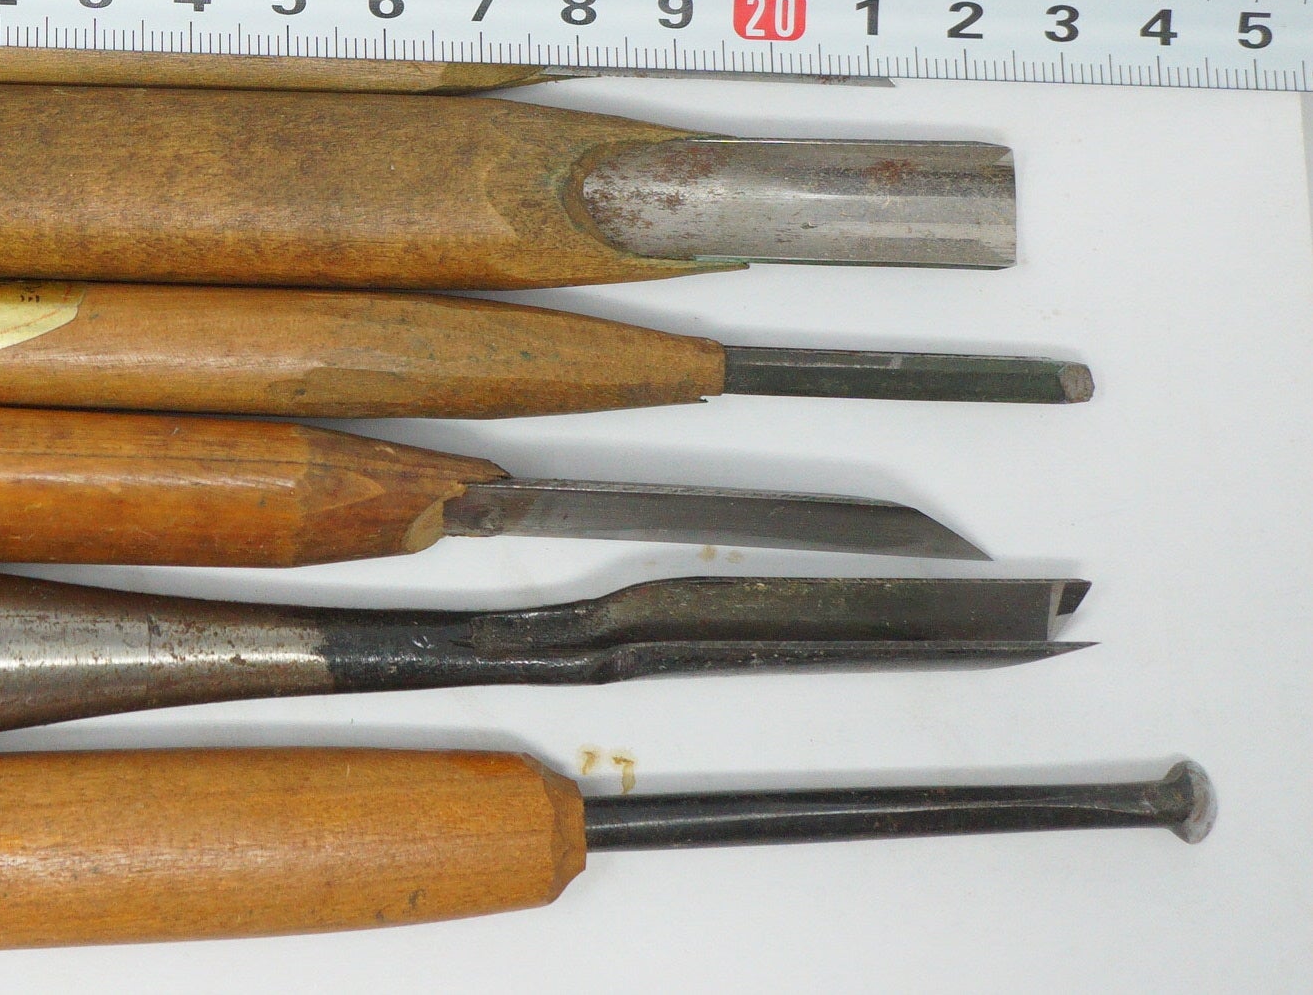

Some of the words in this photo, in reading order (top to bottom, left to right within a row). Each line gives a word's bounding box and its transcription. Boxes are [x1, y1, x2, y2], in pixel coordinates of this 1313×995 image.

[856, 0, 880, 35] 1
[947, 2, 983, 39] 2
[1044, 5, 1080, 42] 3
[1140, 9, 1178, 45] 4
[1238, 12, 1273, 49] 5
